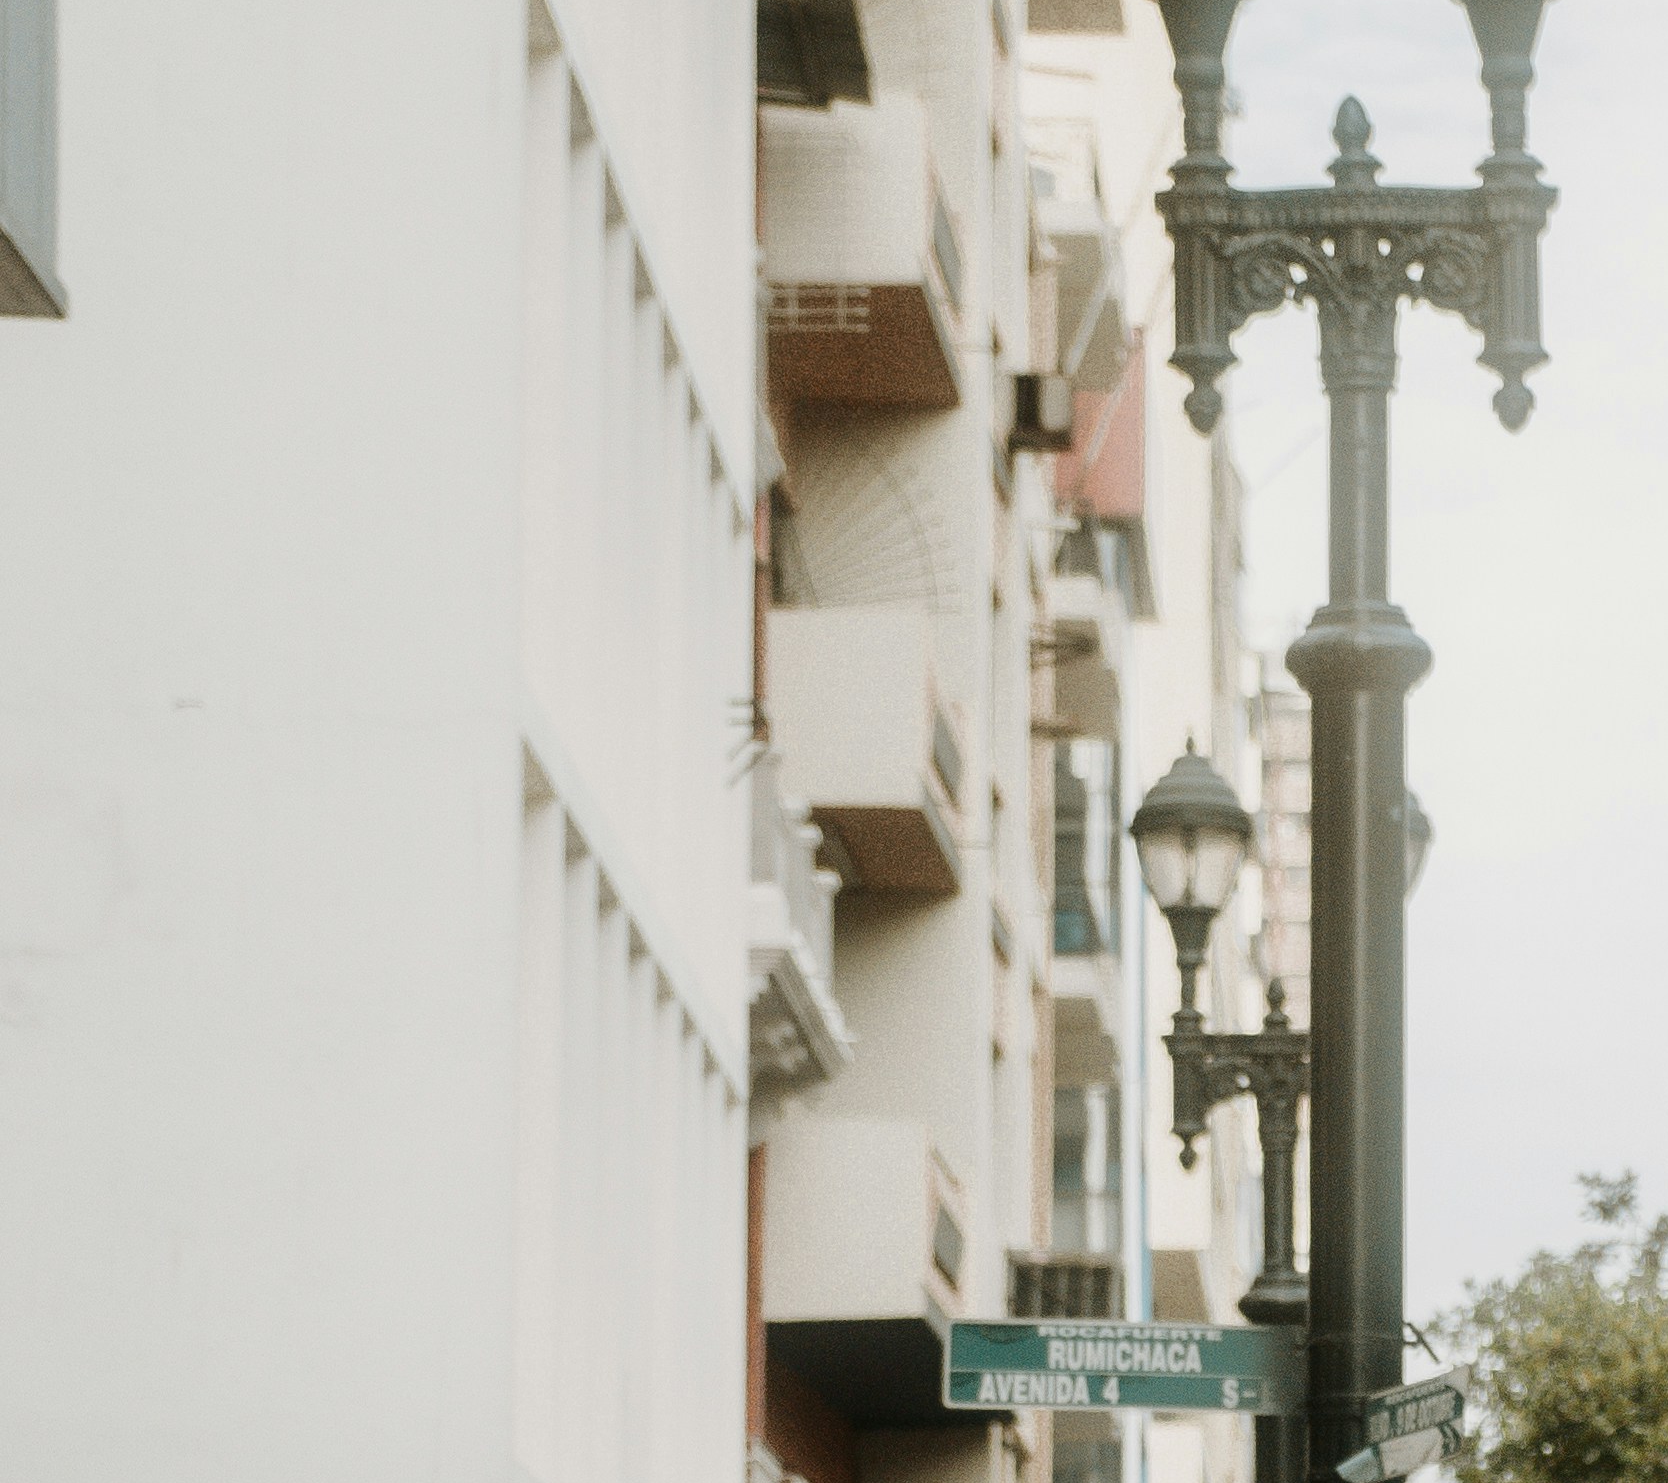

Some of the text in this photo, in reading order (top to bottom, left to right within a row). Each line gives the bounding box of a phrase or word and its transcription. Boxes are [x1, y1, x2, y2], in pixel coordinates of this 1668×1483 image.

[1048, 1340, 1202, 1373] RUMICHACA
[977, 1373, 1091, 1405] AVENIDA
[1102, 1377, 1120, 1405] 4
